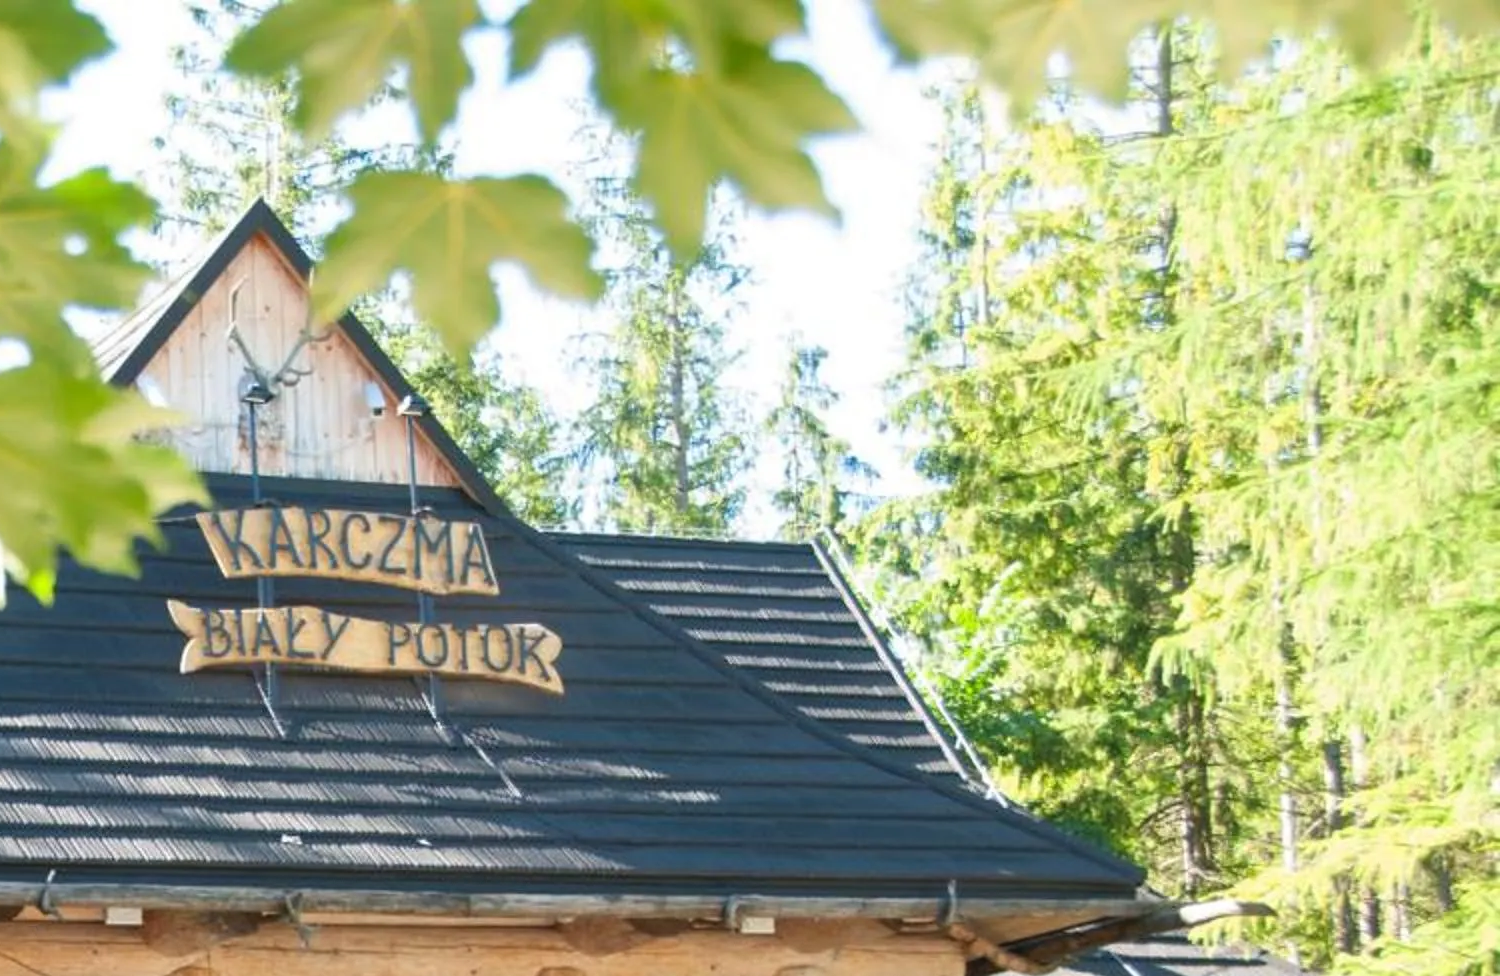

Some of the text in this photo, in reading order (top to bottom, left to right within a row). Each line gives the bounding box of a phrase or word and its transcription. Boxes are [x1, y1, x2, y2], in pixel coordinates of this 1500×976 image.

[211, 507, 496, 586] KARCZMA
[203, 608, 552, 683] BIAŁY POTOK
